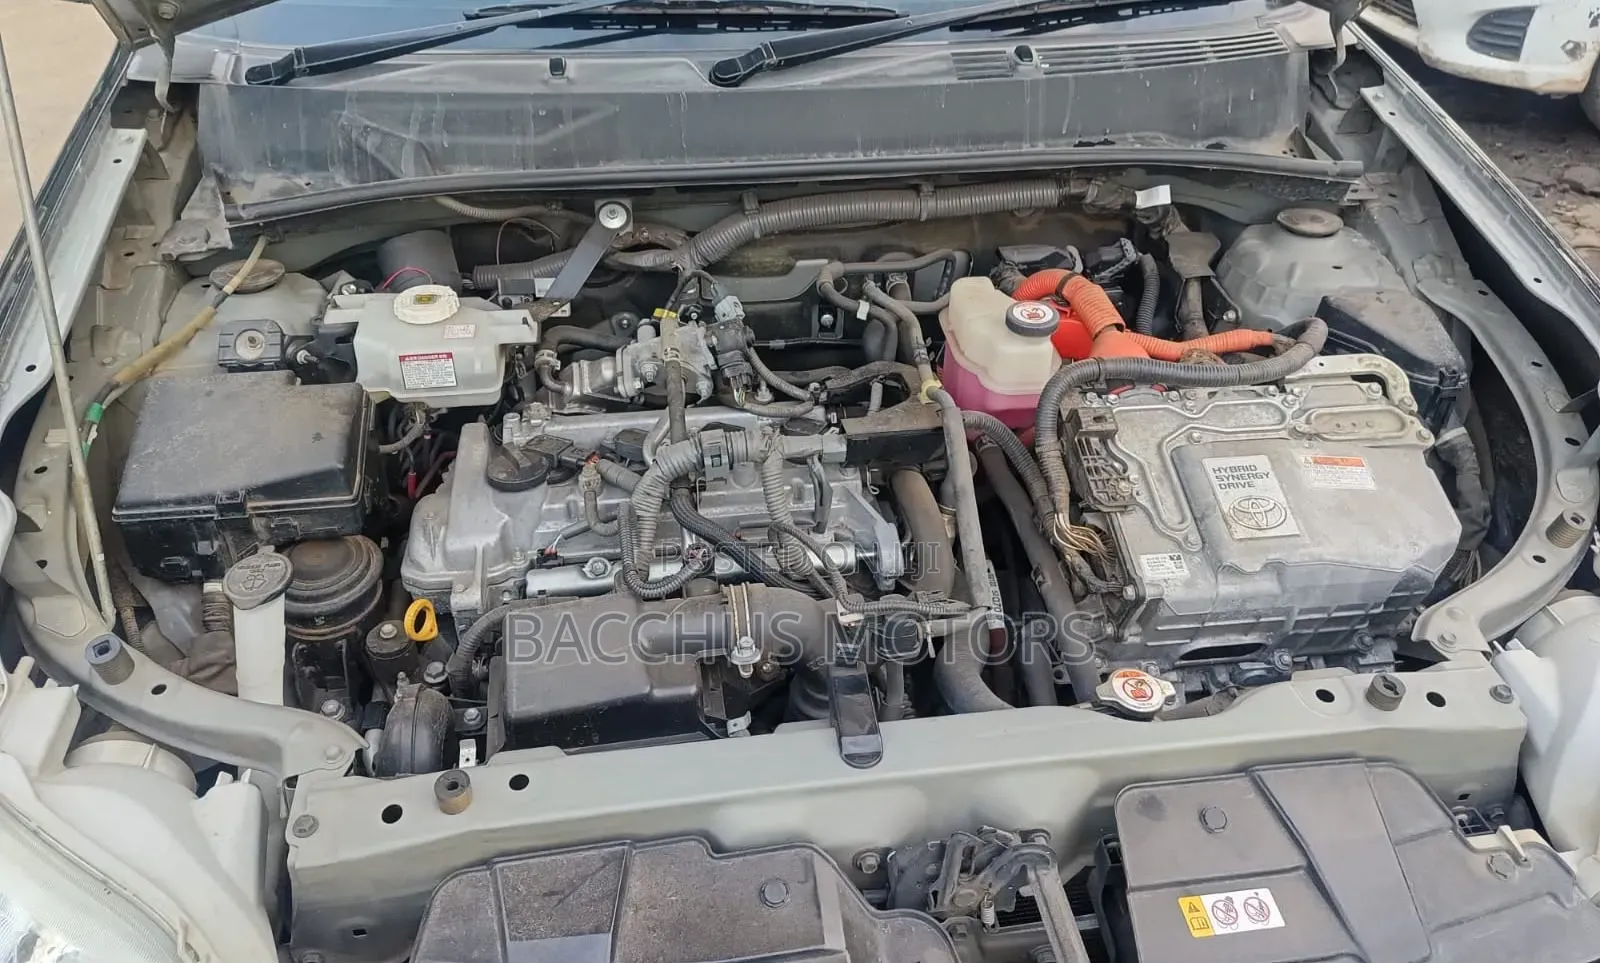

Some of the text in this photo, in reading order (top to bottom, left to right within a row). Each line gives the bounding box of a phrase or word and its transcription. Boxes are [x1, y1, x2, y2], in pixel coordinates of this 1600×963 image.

[1212, 464, 1258, 475] HYBRID
[1215, 471, 1270, 482] SYNERGY
[1218, 481, 1256, 490] DRIVE
